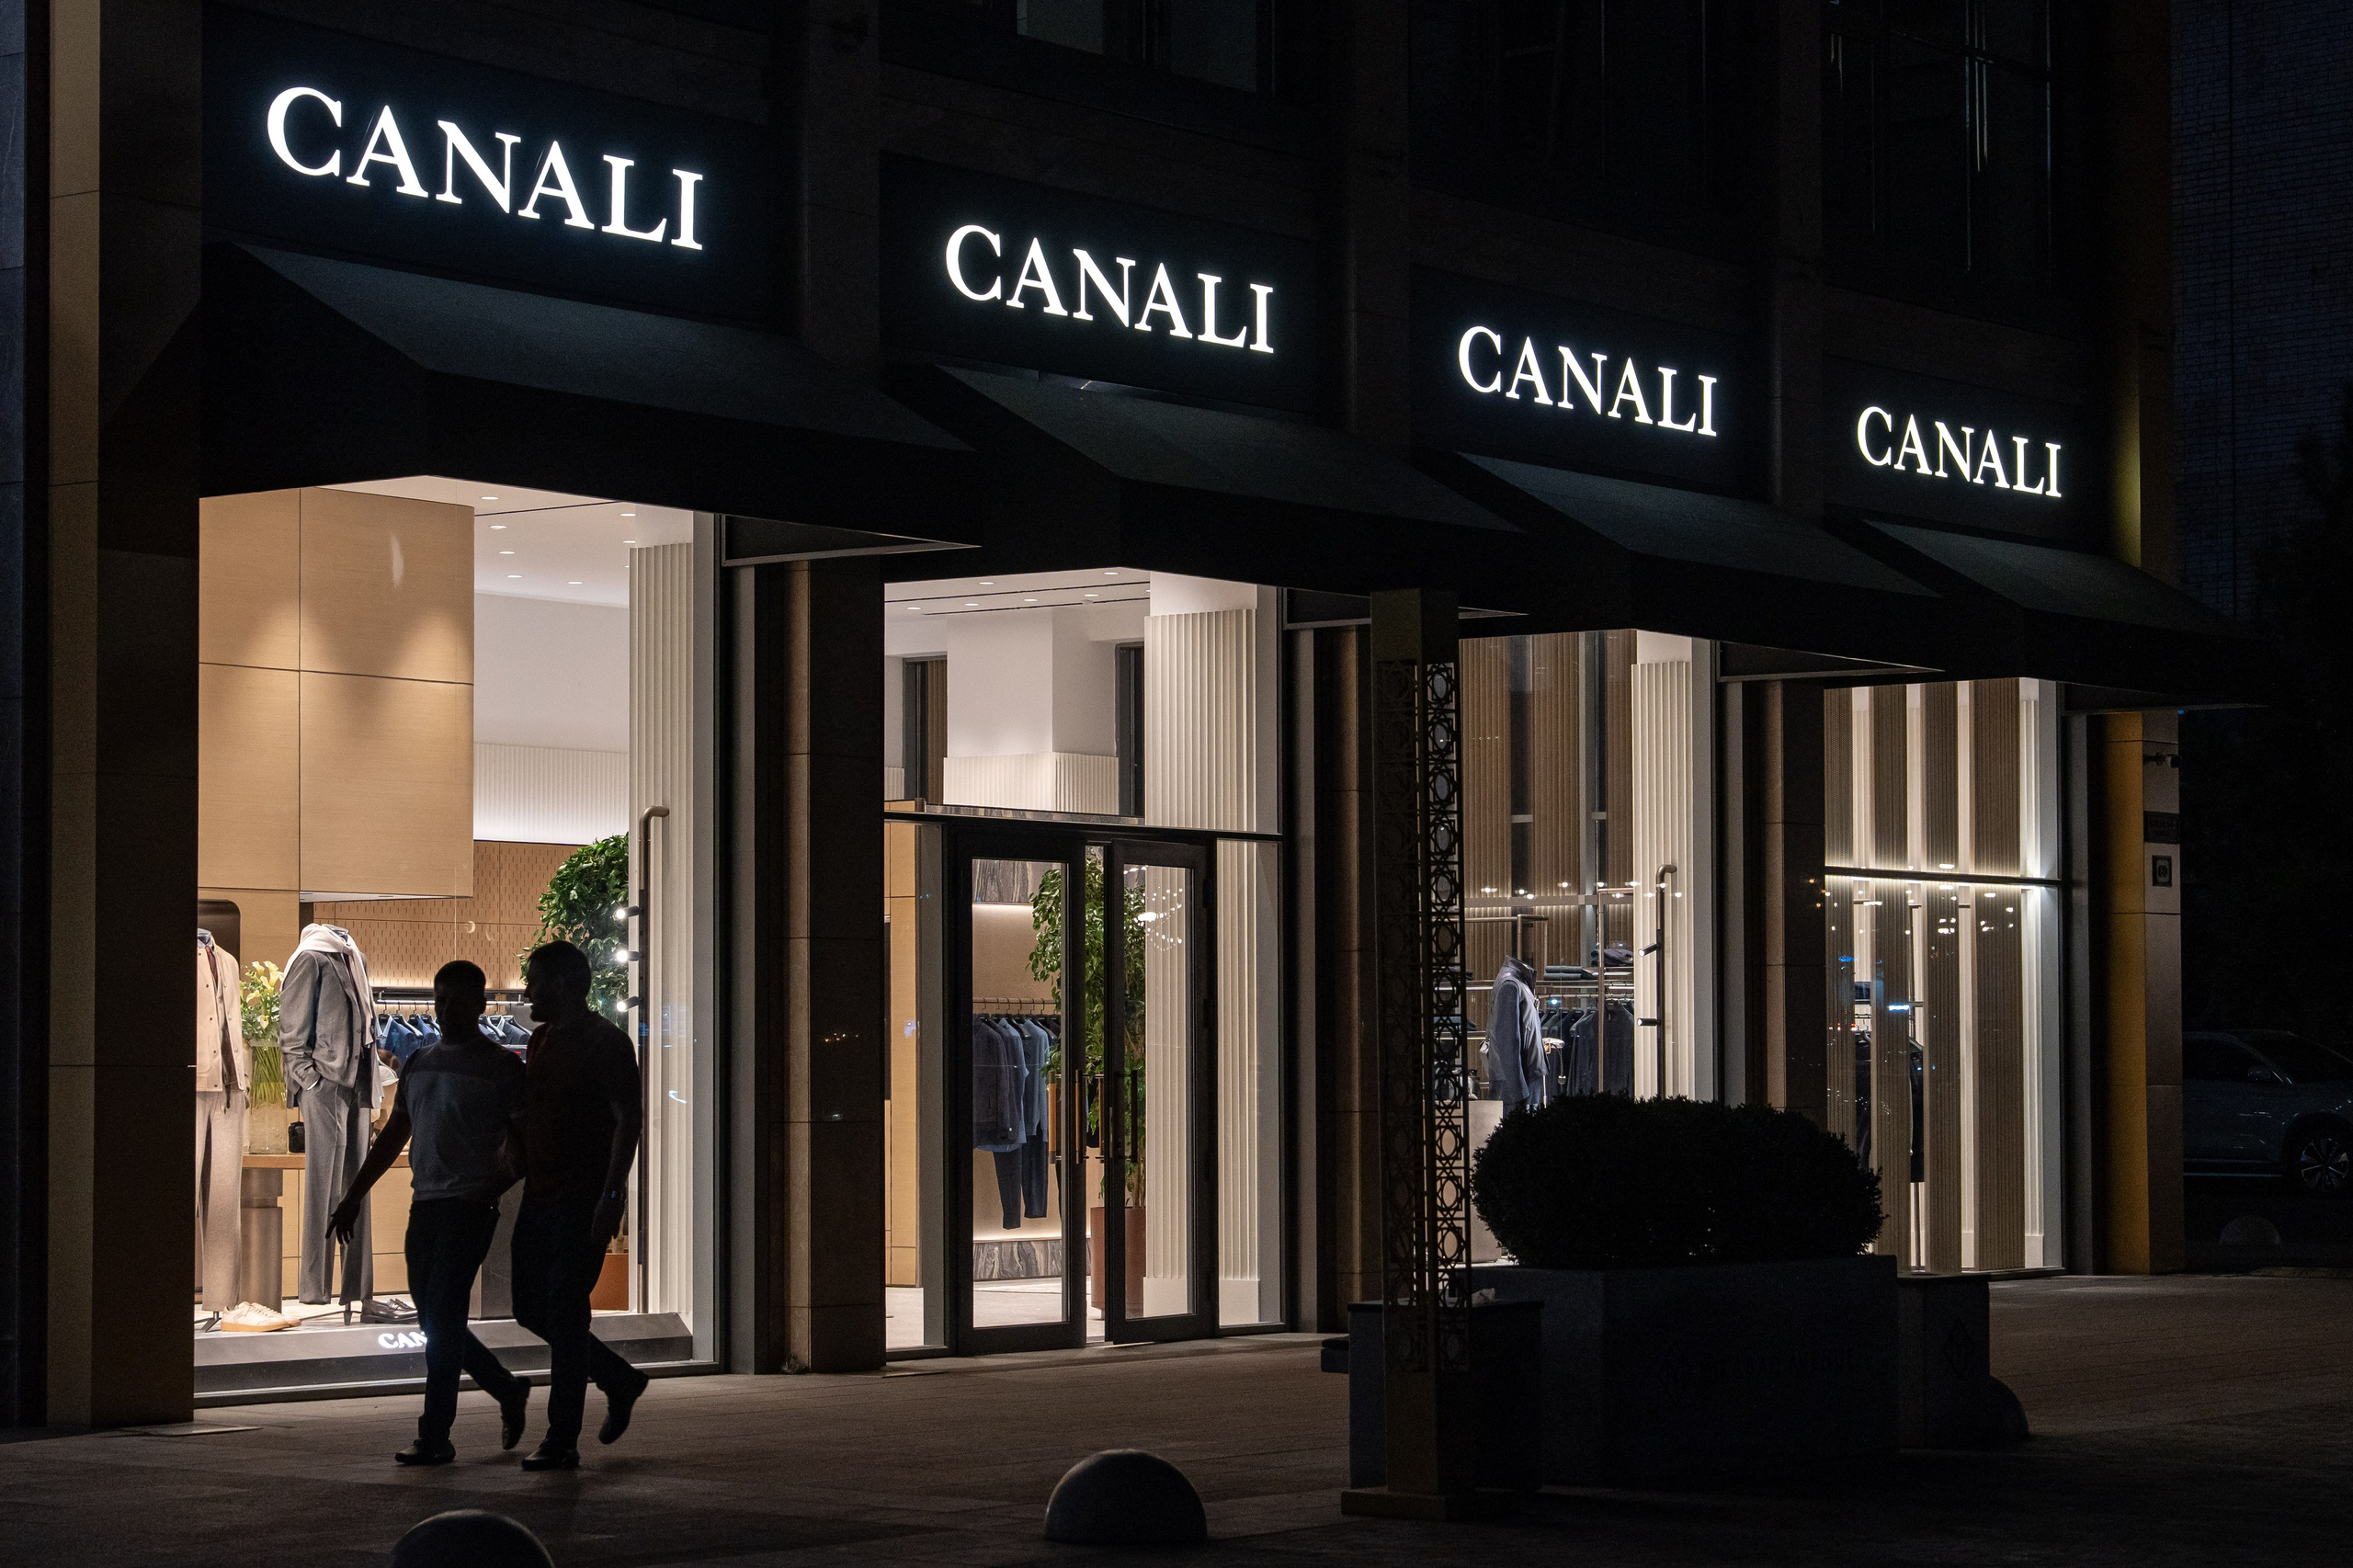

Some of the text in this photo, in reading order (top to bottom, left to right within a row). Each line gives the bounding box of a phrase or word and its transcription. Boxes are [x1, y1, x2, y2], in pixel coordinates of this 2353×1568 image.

[267, 85, 703, 251] CANALI
[945, 224, 1274, 354] CANALI
[1458, 325, 1717, 437] CANALI
[1857, 405, 2062, 498] CANALI
[378, 1331, 428, 1349] CAN
